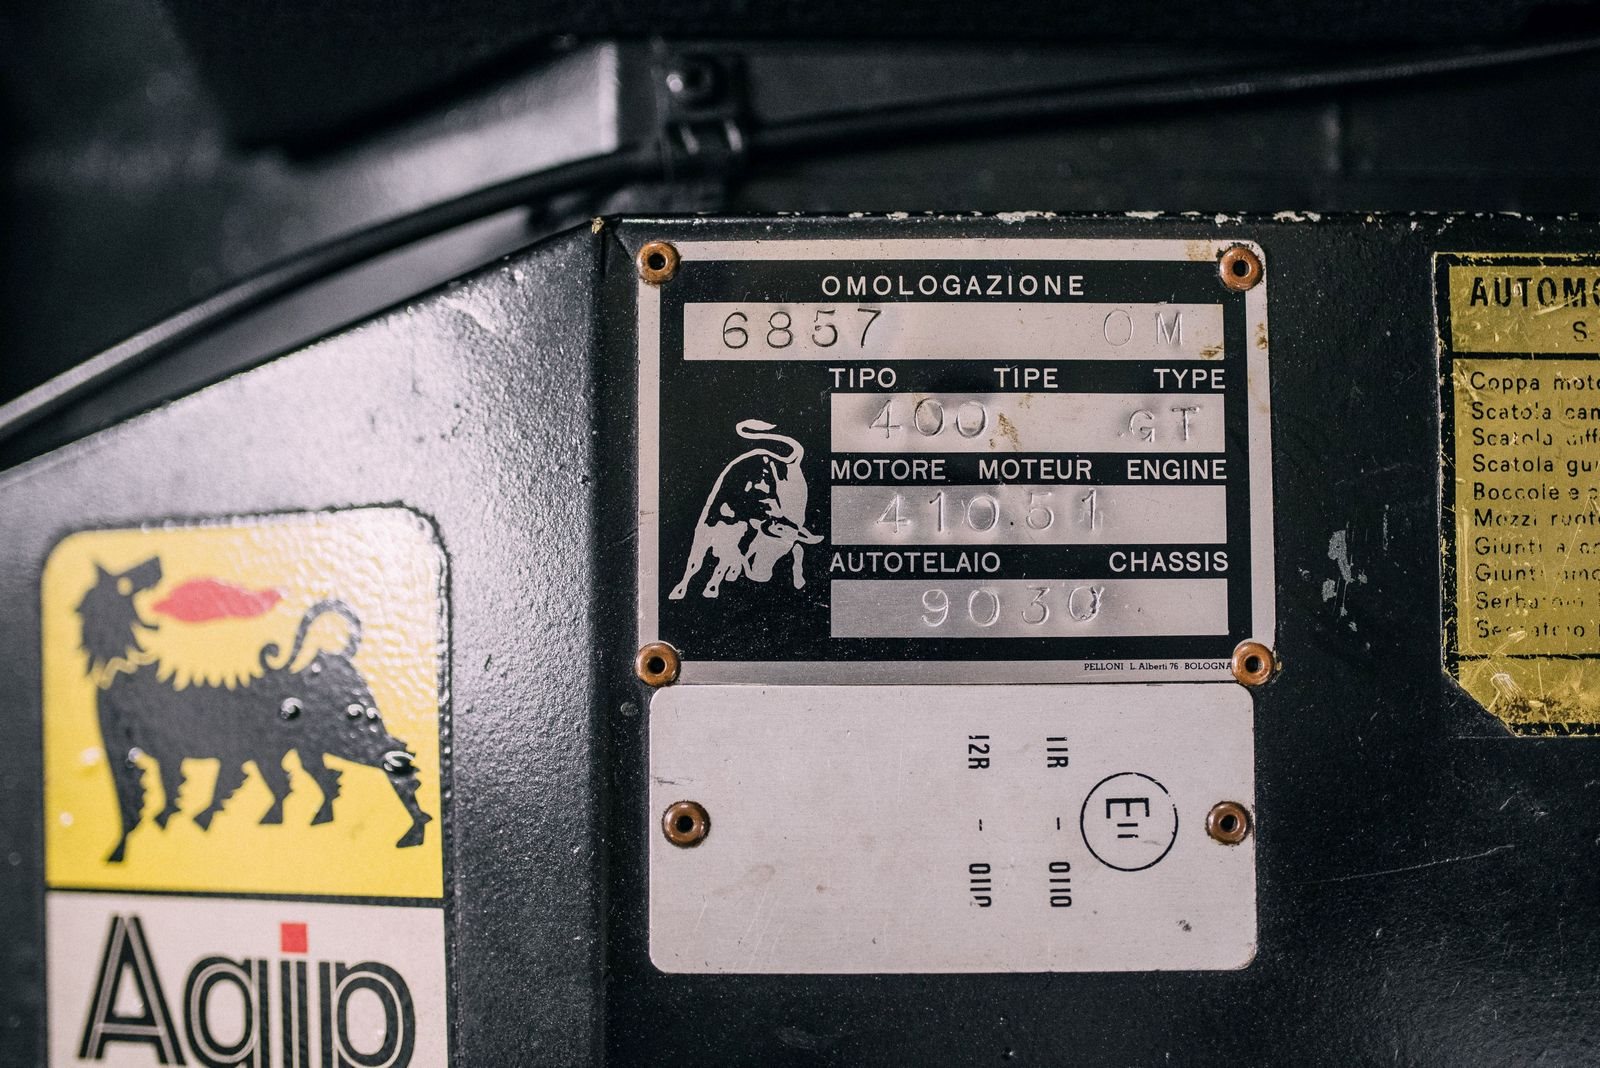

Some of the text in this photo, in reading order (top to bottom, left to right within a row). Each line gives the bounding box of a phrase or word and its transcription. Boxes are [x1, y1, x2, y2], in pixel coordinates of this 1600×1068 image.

[821, 275, 1085, 296] OMOLOGAZIONE
[721, 307, 883, 350] 6857
[828, 366, 1227, 390] TIPO TIPE TYPE
[1470, 371, 1540, 395] Coppa
[868, 398, 1201, 443] 400 GT
[1471, 401, 1552, 421] Scatola
[830, 458, 1228, 481] MOTORE MOTEUR ENGINE
[1472, 453, 1554, 473] Scatola
[829, 550, 1230, 574] AUTOTELAIO CHASSIS
[921, 586, 1105, 628] 9030
[1084, 662, 1124, 672] PELLONI
[1138, 661, 1168, 671] Alberti
[1169, 662, 1179, 671] 76
[1184, 661, 1232, 671] BOLOGNA
[1048, 861, 1073, 908] 0110
[78, 915, 417, 1068] Agip
